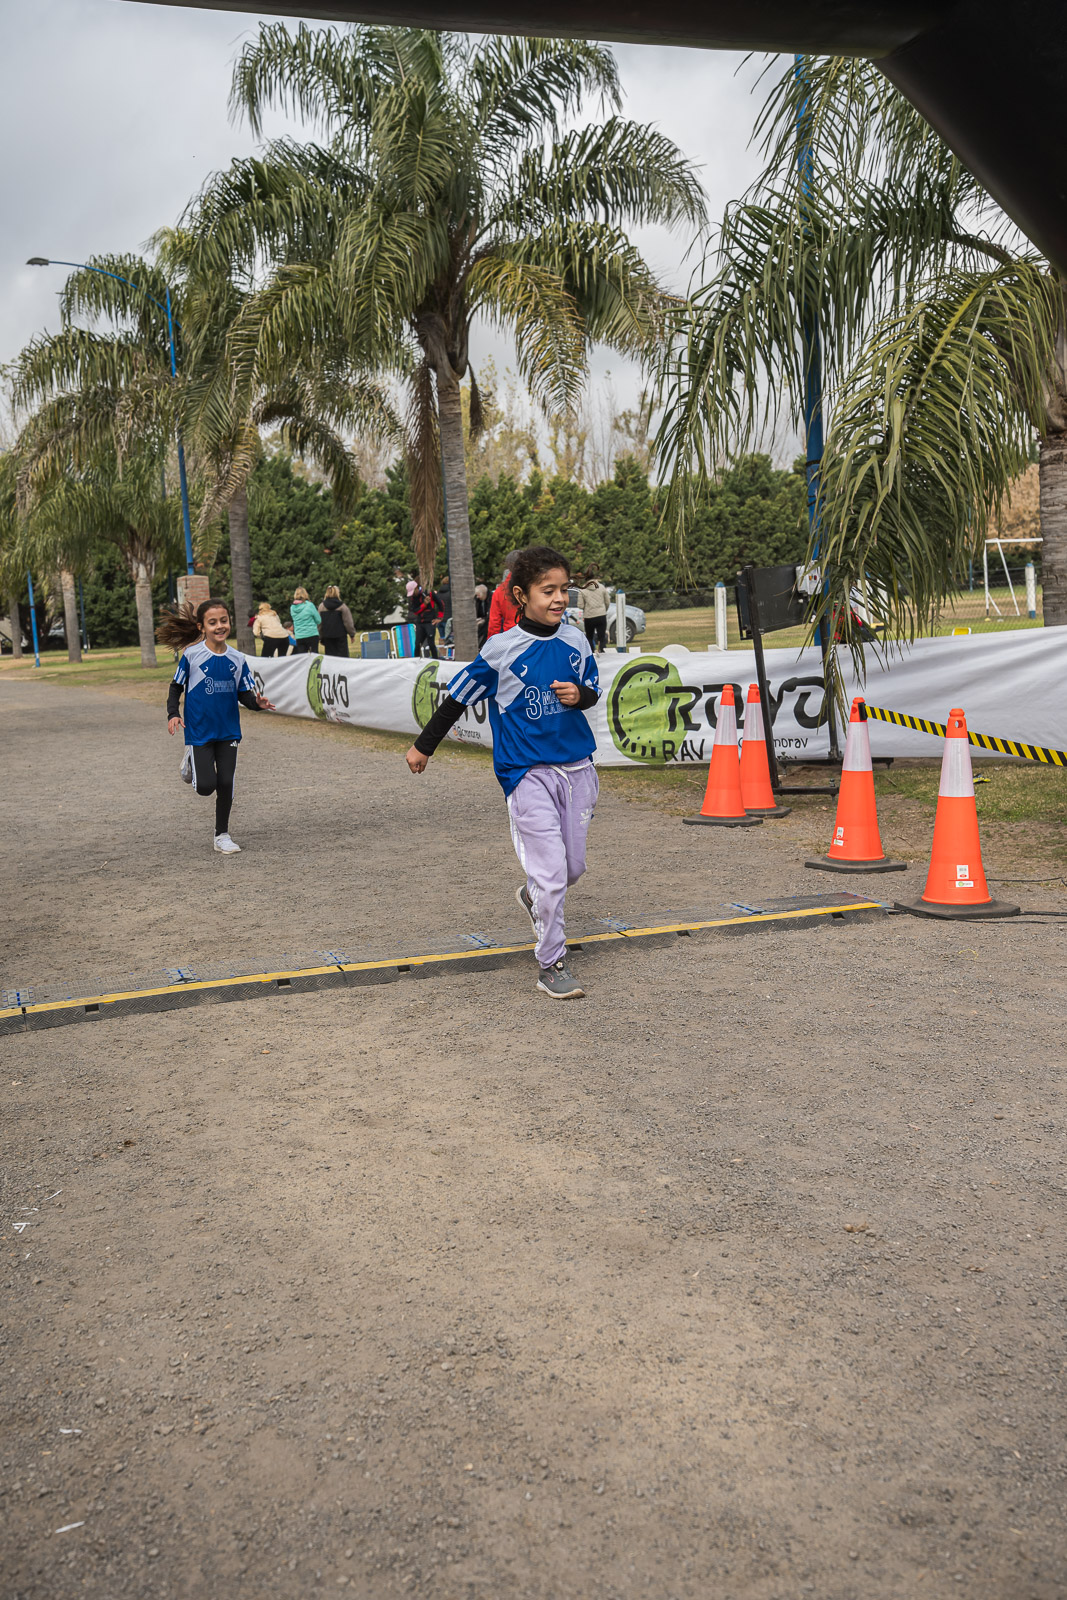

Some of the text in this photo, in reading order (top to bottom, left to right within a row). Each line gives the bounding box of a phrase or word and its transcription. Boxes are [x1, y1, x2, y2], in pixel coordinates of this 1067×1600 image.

[205, 677, 214, 694] 3
[525, 686, 542, 720] 3
[663, 740, 705, 761] RAV
